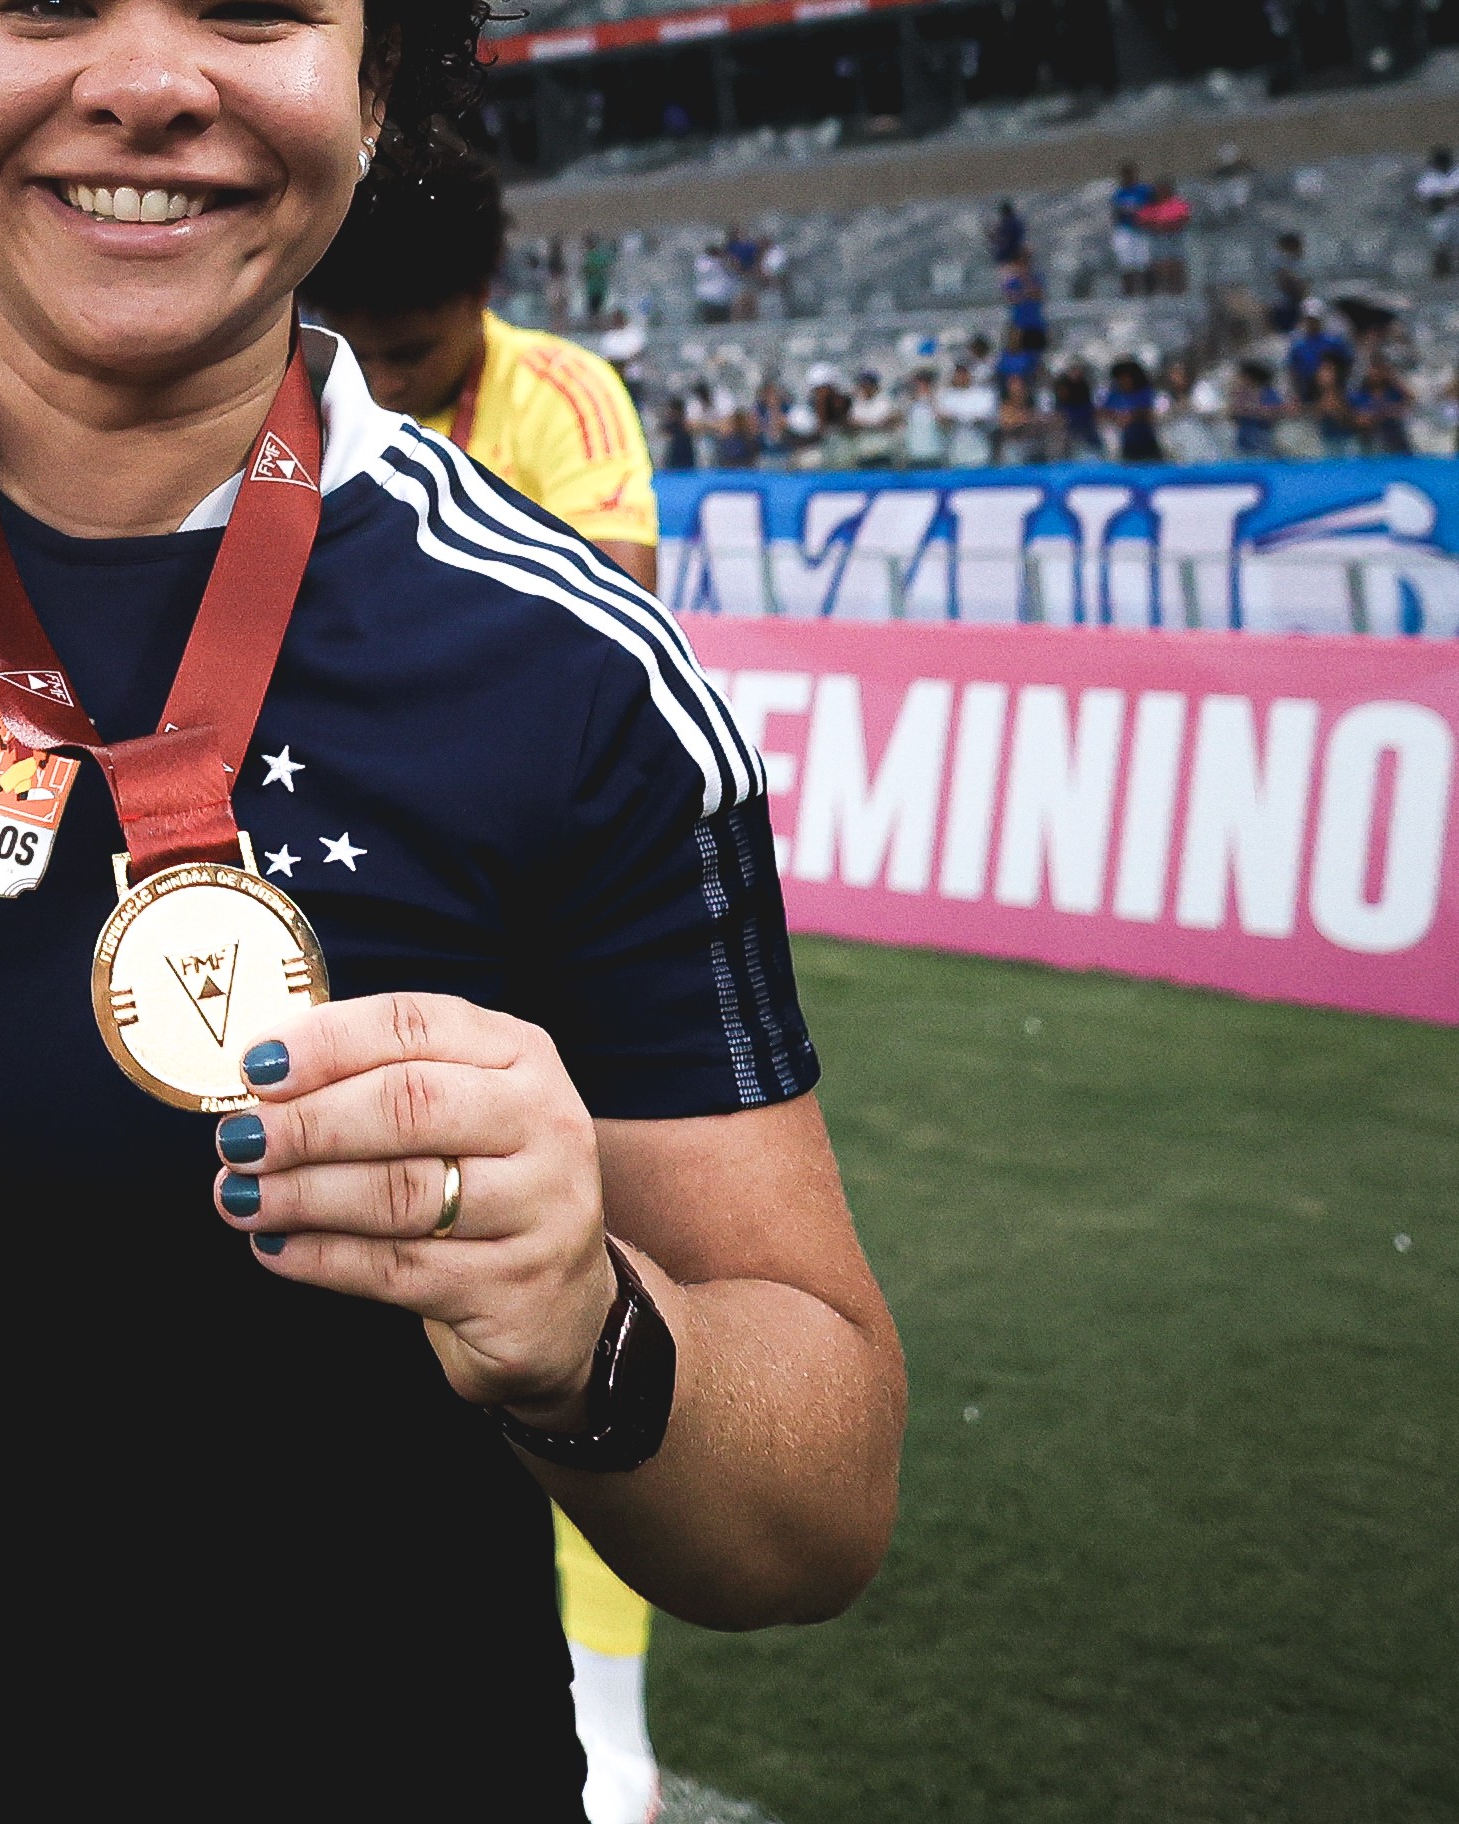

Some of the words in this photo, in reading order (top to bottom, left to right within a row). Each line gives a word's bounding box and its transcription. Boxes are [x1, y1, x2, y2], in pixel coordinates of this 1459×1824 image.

[257, 441, 281, 477] FMF
[44, 673, 67, 701] FMF
[704, 667, 1455, 955] EMININO
[181, 948, 226, 976] FMF
